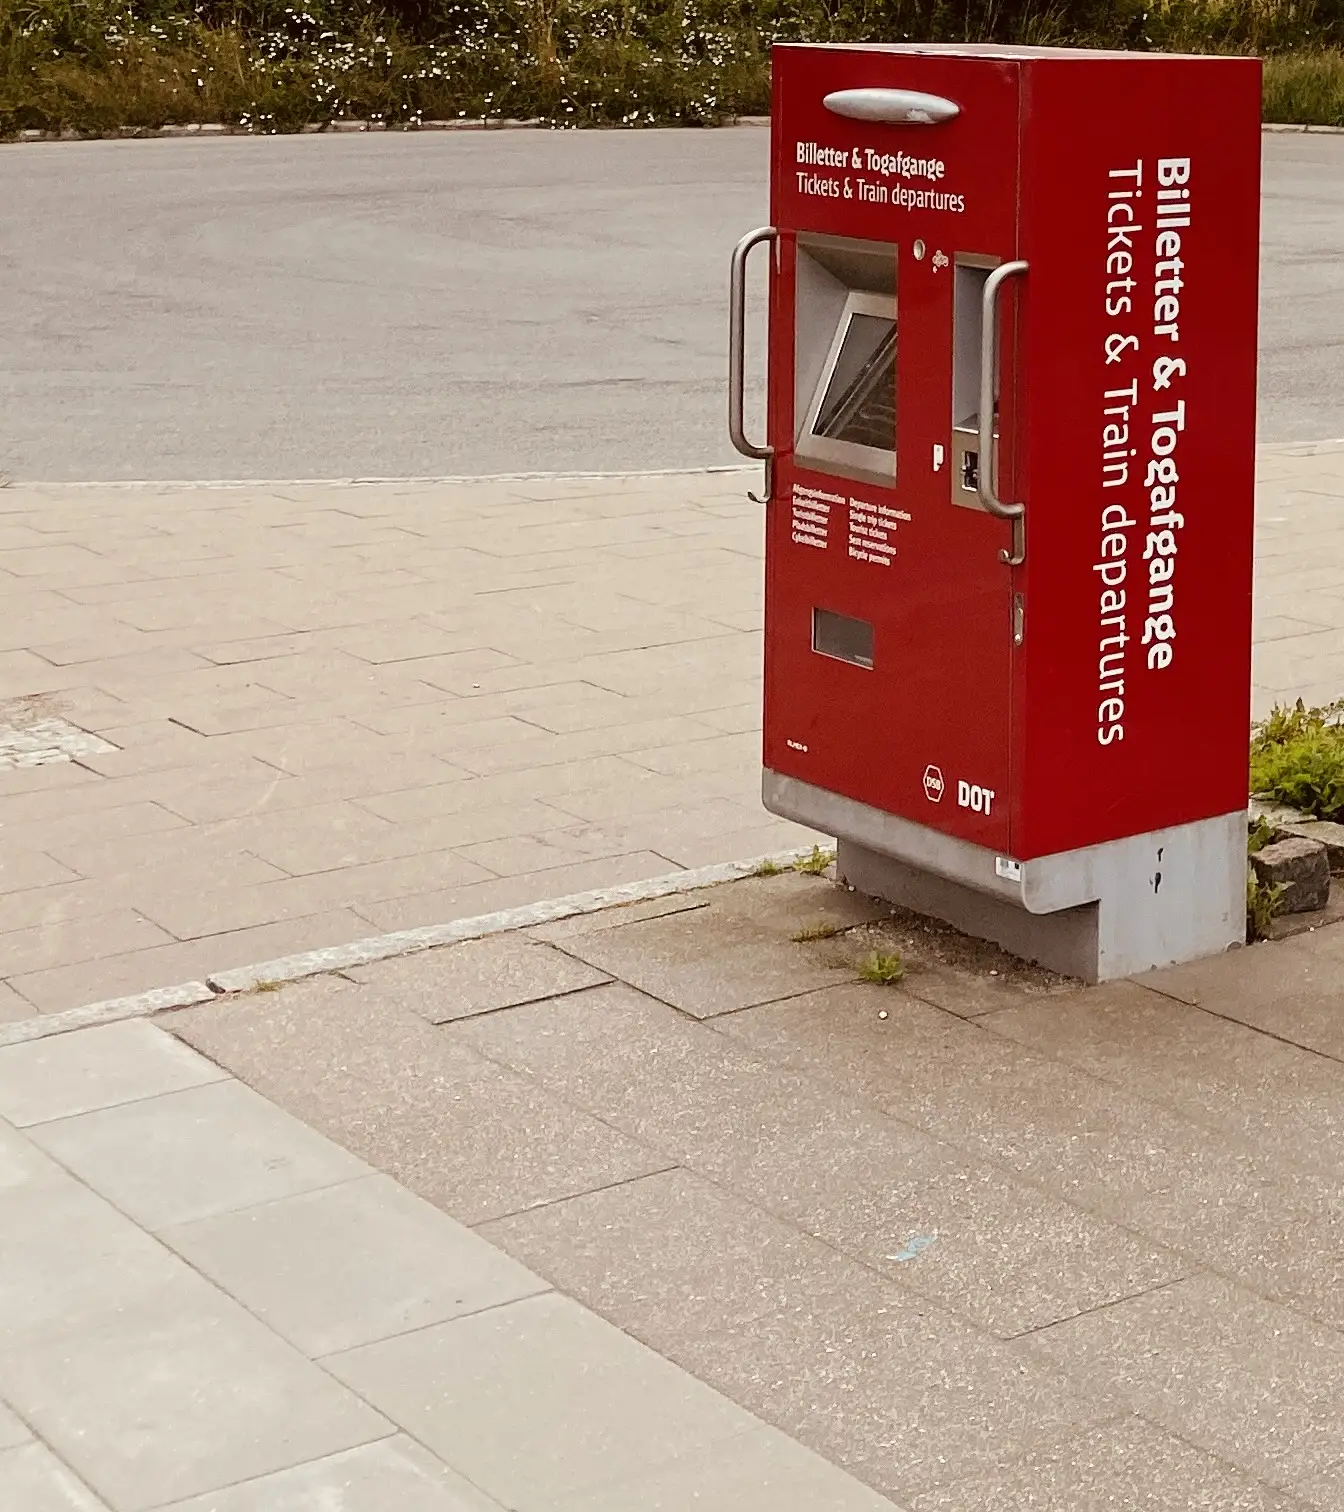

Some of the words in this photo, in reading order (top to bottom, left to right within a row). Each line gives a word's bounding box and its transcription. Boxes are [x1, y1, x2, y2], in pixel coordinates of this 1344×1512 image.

[796, 141, 849, 168] Billetter
[851, 147, 863, 169] &
[864, 148, 945, 181] Togafgange
[796, 172, 840, 198] Tickets
[843, 177, 853, 199] &
[856, 178, 888, 204] Train
[891, 182, 965, 213] departures
[1104, 159, 1143, 317] Tickets
[1154, 156, 1191, 342] Billetter
[1104, 333, 1140, 365] &
[1153, 356, 1187, 392] &
[1102, 378, 1138, 488] Train
[1141, 399, 1186, 671] Togafgange
[1092, 502, 1137, 746] departures
[957, 779, 995, 816] DOT
